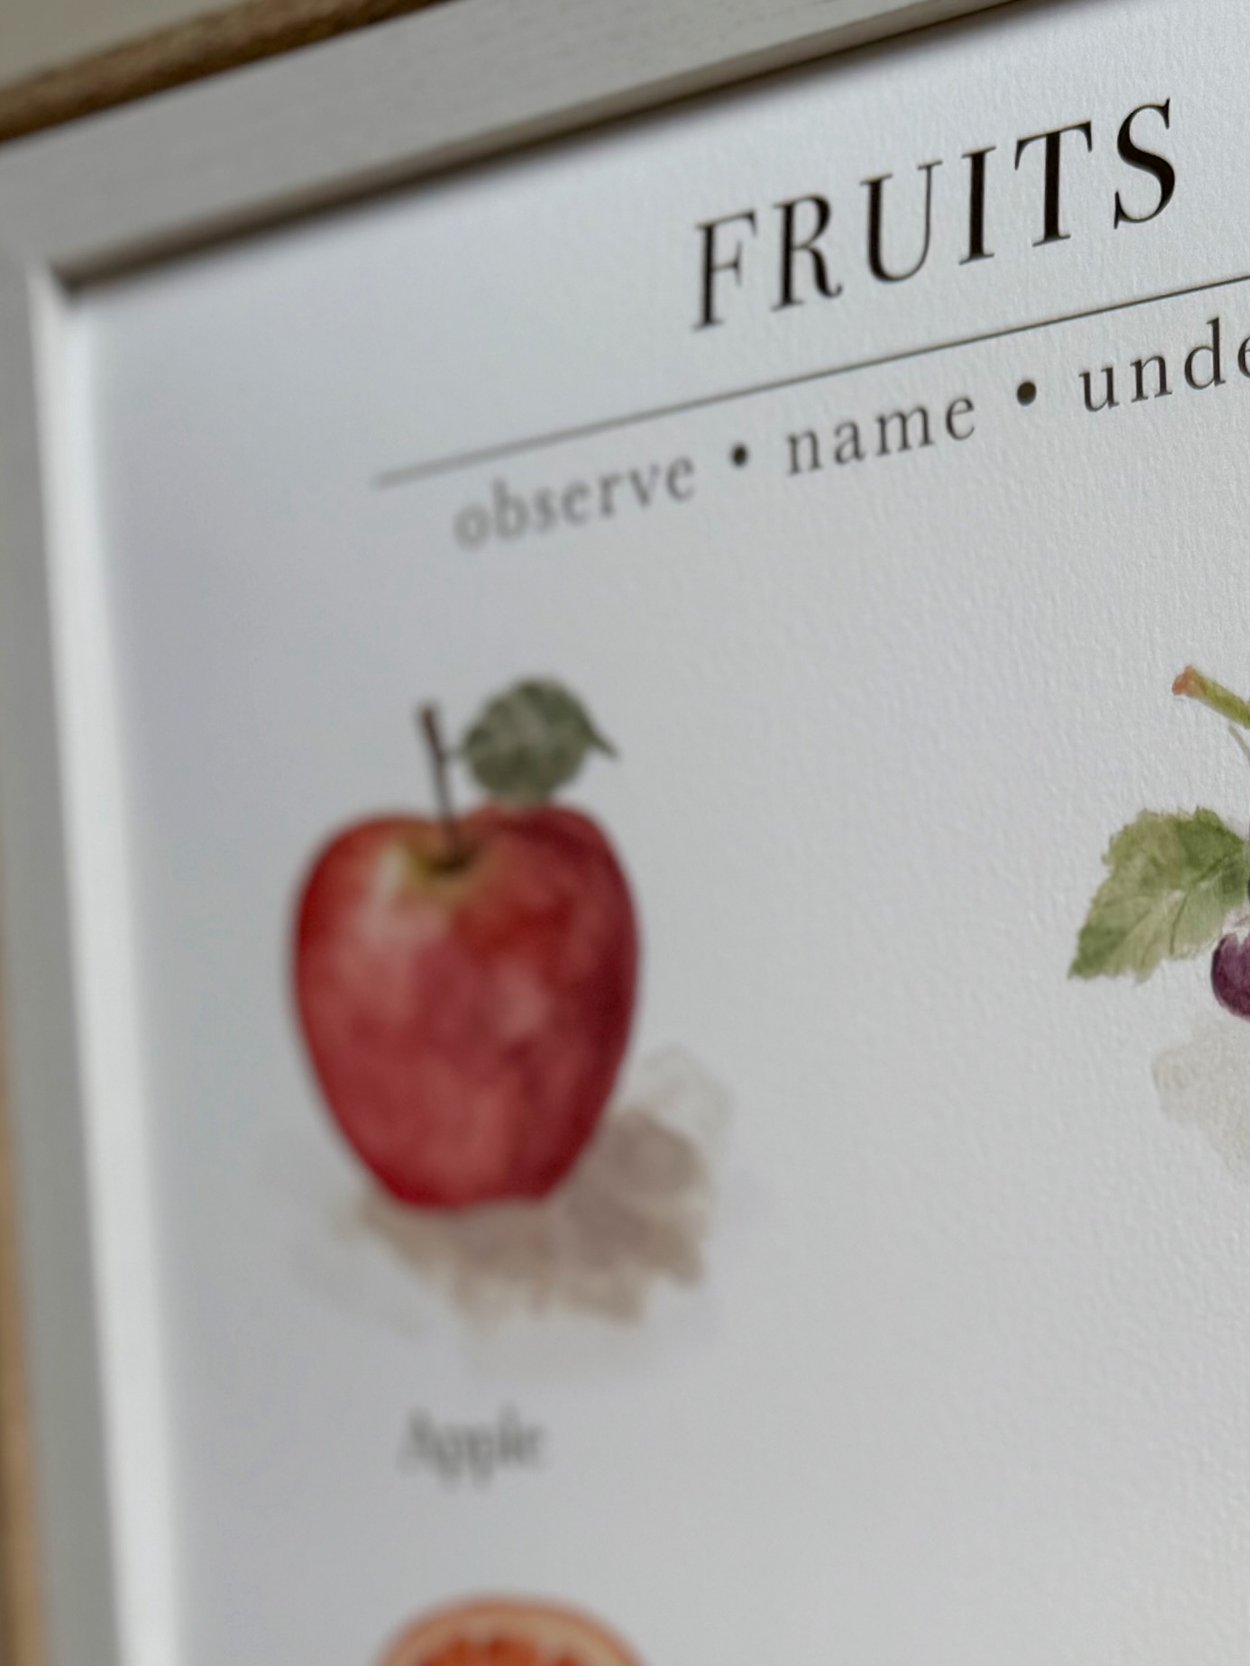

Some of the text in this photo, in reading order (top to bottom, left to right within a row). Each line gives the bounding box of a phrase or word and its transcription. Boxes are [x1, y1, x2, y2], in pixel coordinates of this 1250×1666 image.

[693, 98, 1177, 331] FRUITS
[452, 452, 696, 551] observe
[785, 393, 977, 476] name
